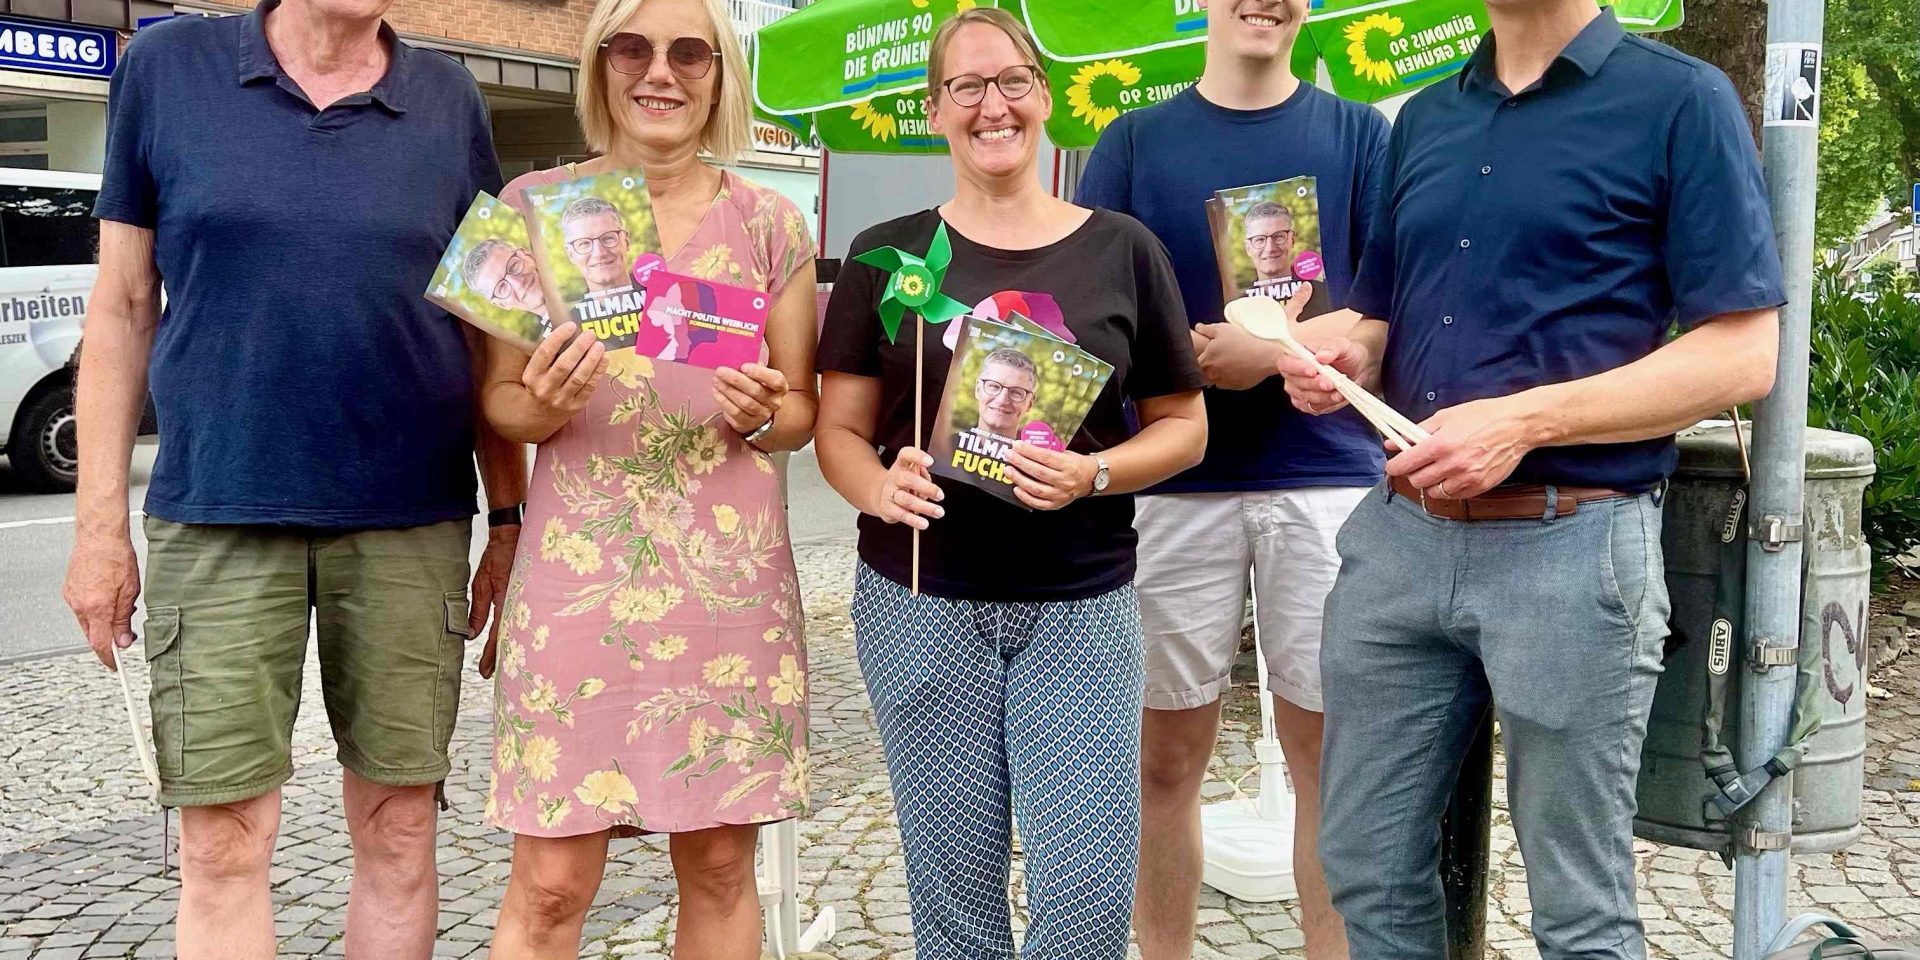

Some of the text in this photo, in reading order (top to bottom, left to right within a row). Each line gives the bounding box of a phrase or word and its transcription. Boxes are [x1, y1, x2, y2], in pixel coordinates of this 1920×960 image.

[845, 12, 933, 54] BÜNDNIS 90
[844, 40, 931, 81] DIE GRÜNEN
[0, 295, 85, 322] rbeiten
[575, 289, 647, 321] TILMAN
[665, 306, 693, 319] MACHT
[693, 311, 722, 325] POLITIK
[721, 317, 760, 333] WEIBLICH!
[0, 333, 27, 345] ESZEK
[581, 312, 645, 340] FUCH
[959, 431, 1014, 464] TILMA
[1713, 625, 1727, 667] ABUS
